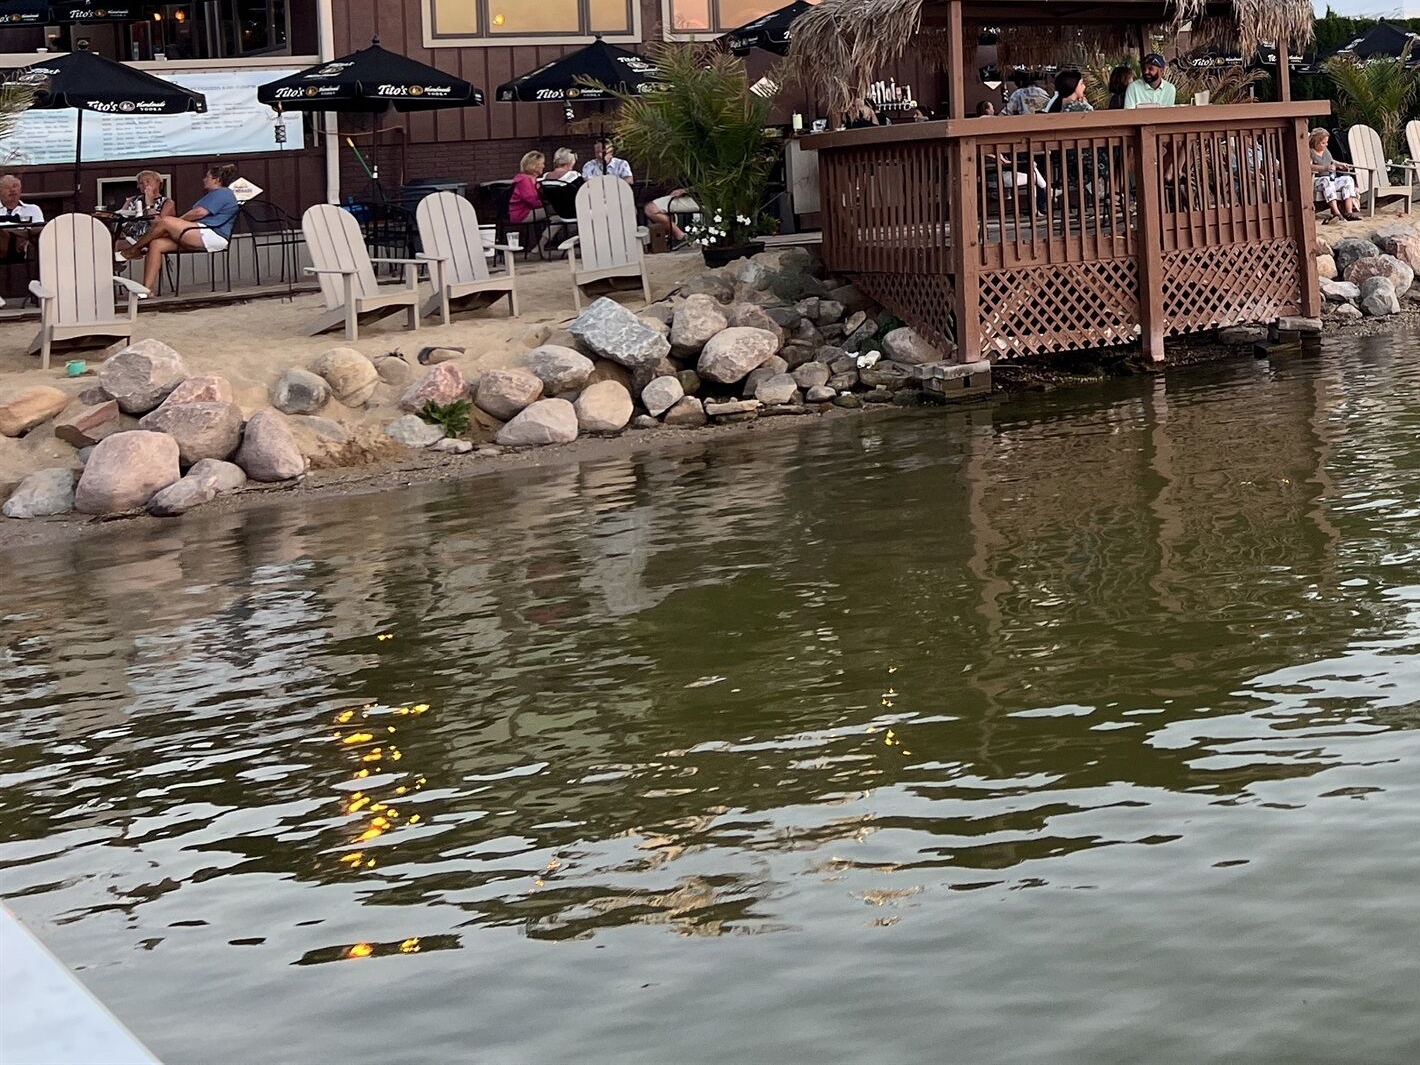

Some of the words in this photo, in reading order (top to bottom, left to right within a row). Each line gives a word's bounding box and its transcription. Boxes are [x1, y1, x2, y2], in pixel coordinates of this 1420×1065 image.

[69, 9, 94, 19] Tito's
[275, 87, 305, 98] Tito's
[378, 84, 408, 96] Tito's
[536, 88, 564, 99] Tito's
[87, 100, 118, 112] Tito's
